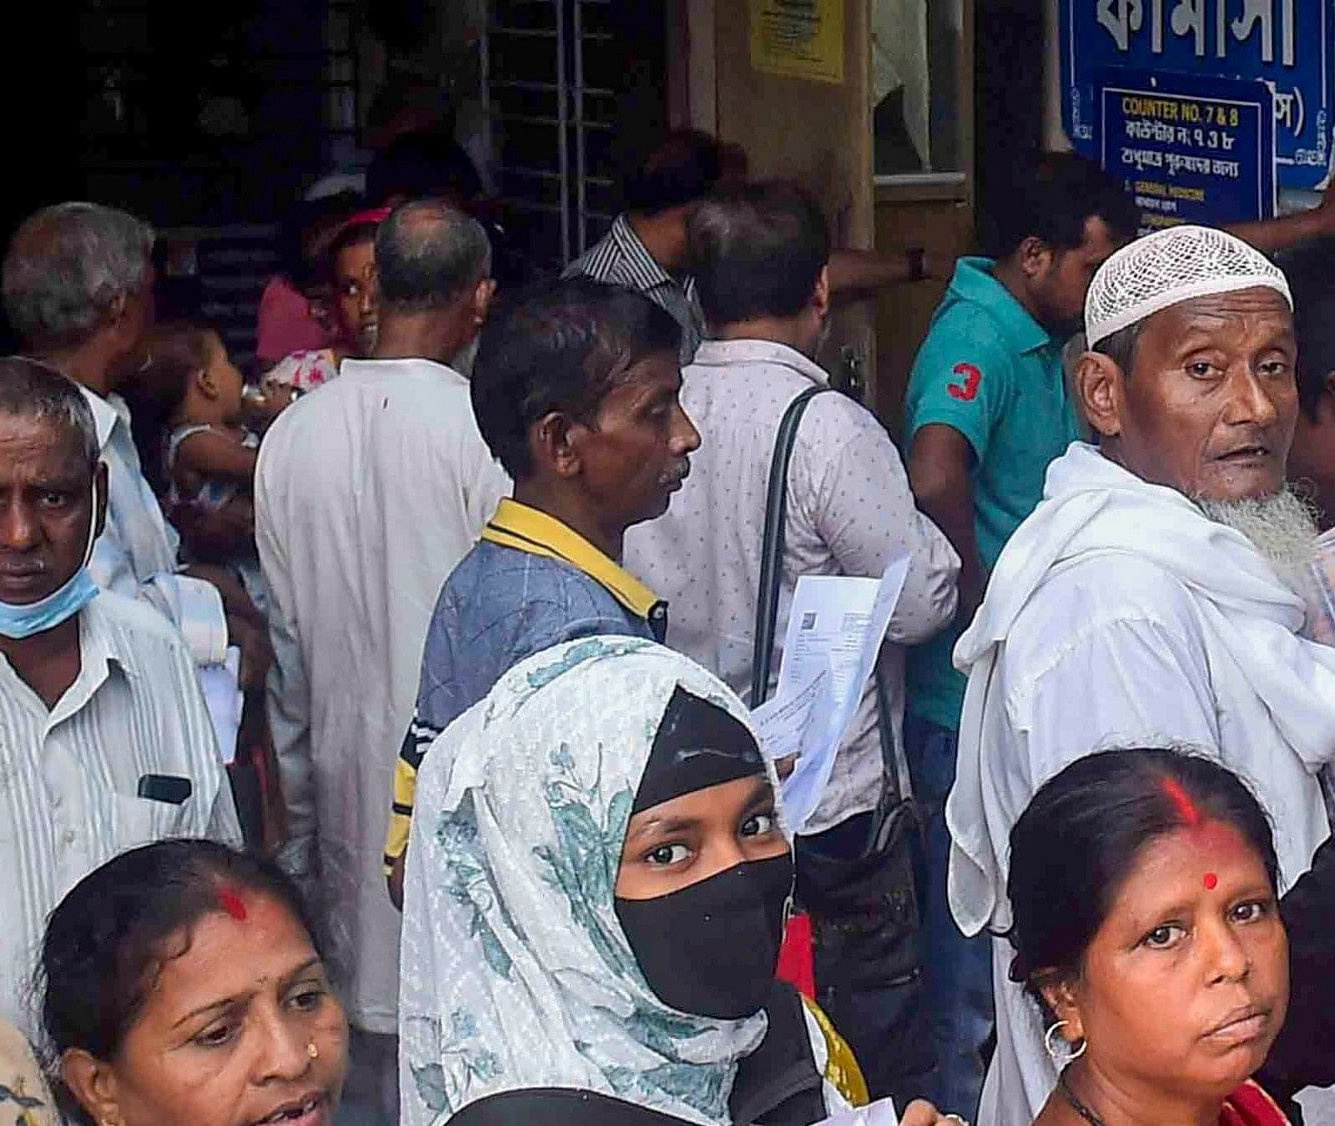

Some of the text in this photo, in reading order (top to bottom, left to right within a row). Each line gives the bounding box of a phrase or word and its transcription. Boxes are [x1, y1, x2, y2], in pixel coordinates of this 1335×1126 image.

[1122, 97, 1239, 127] COUNTER NO. 7 & 8
[947, 362, 981, 401] 3
